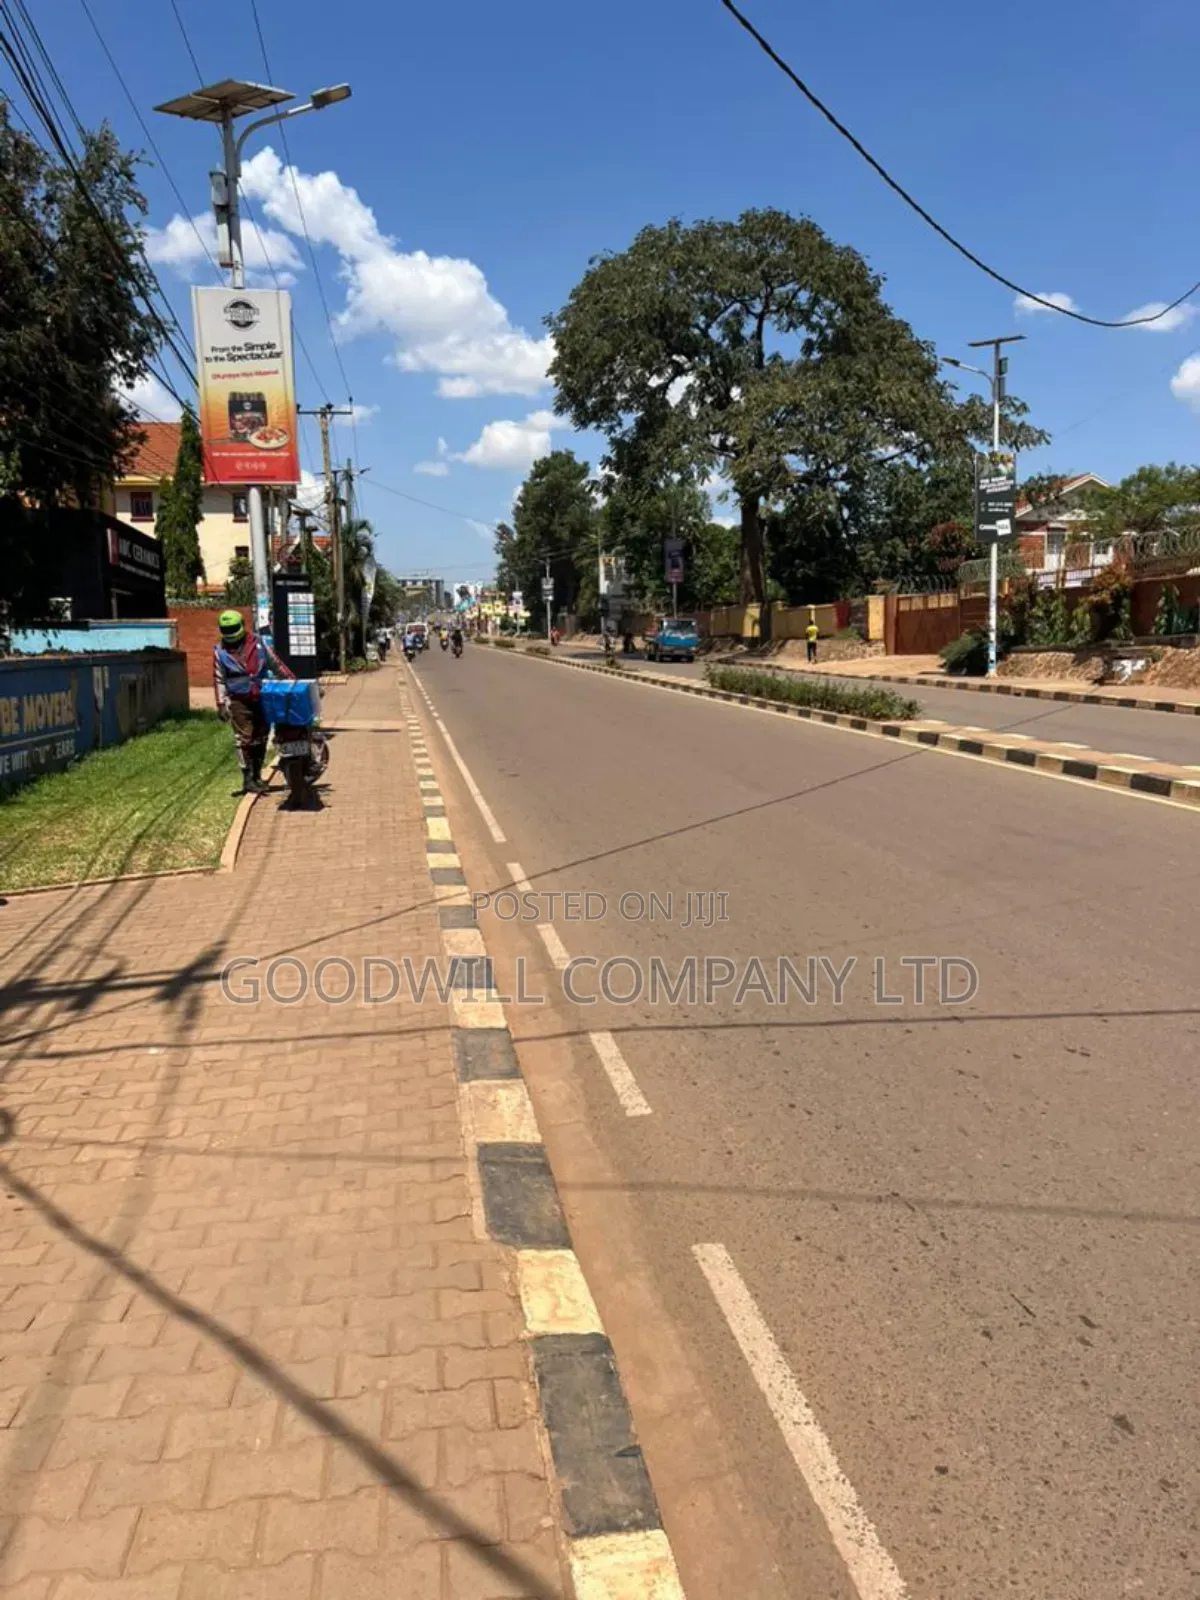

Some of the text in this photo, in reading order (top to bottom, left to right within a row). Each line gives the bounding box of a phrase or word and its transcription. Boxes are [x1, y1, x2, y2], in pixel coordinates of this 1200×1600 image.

[211, 345, 230, 353] From
[244, 341, 276, 352] Simple
[204, 351, 283, 363] to the Spectacular
